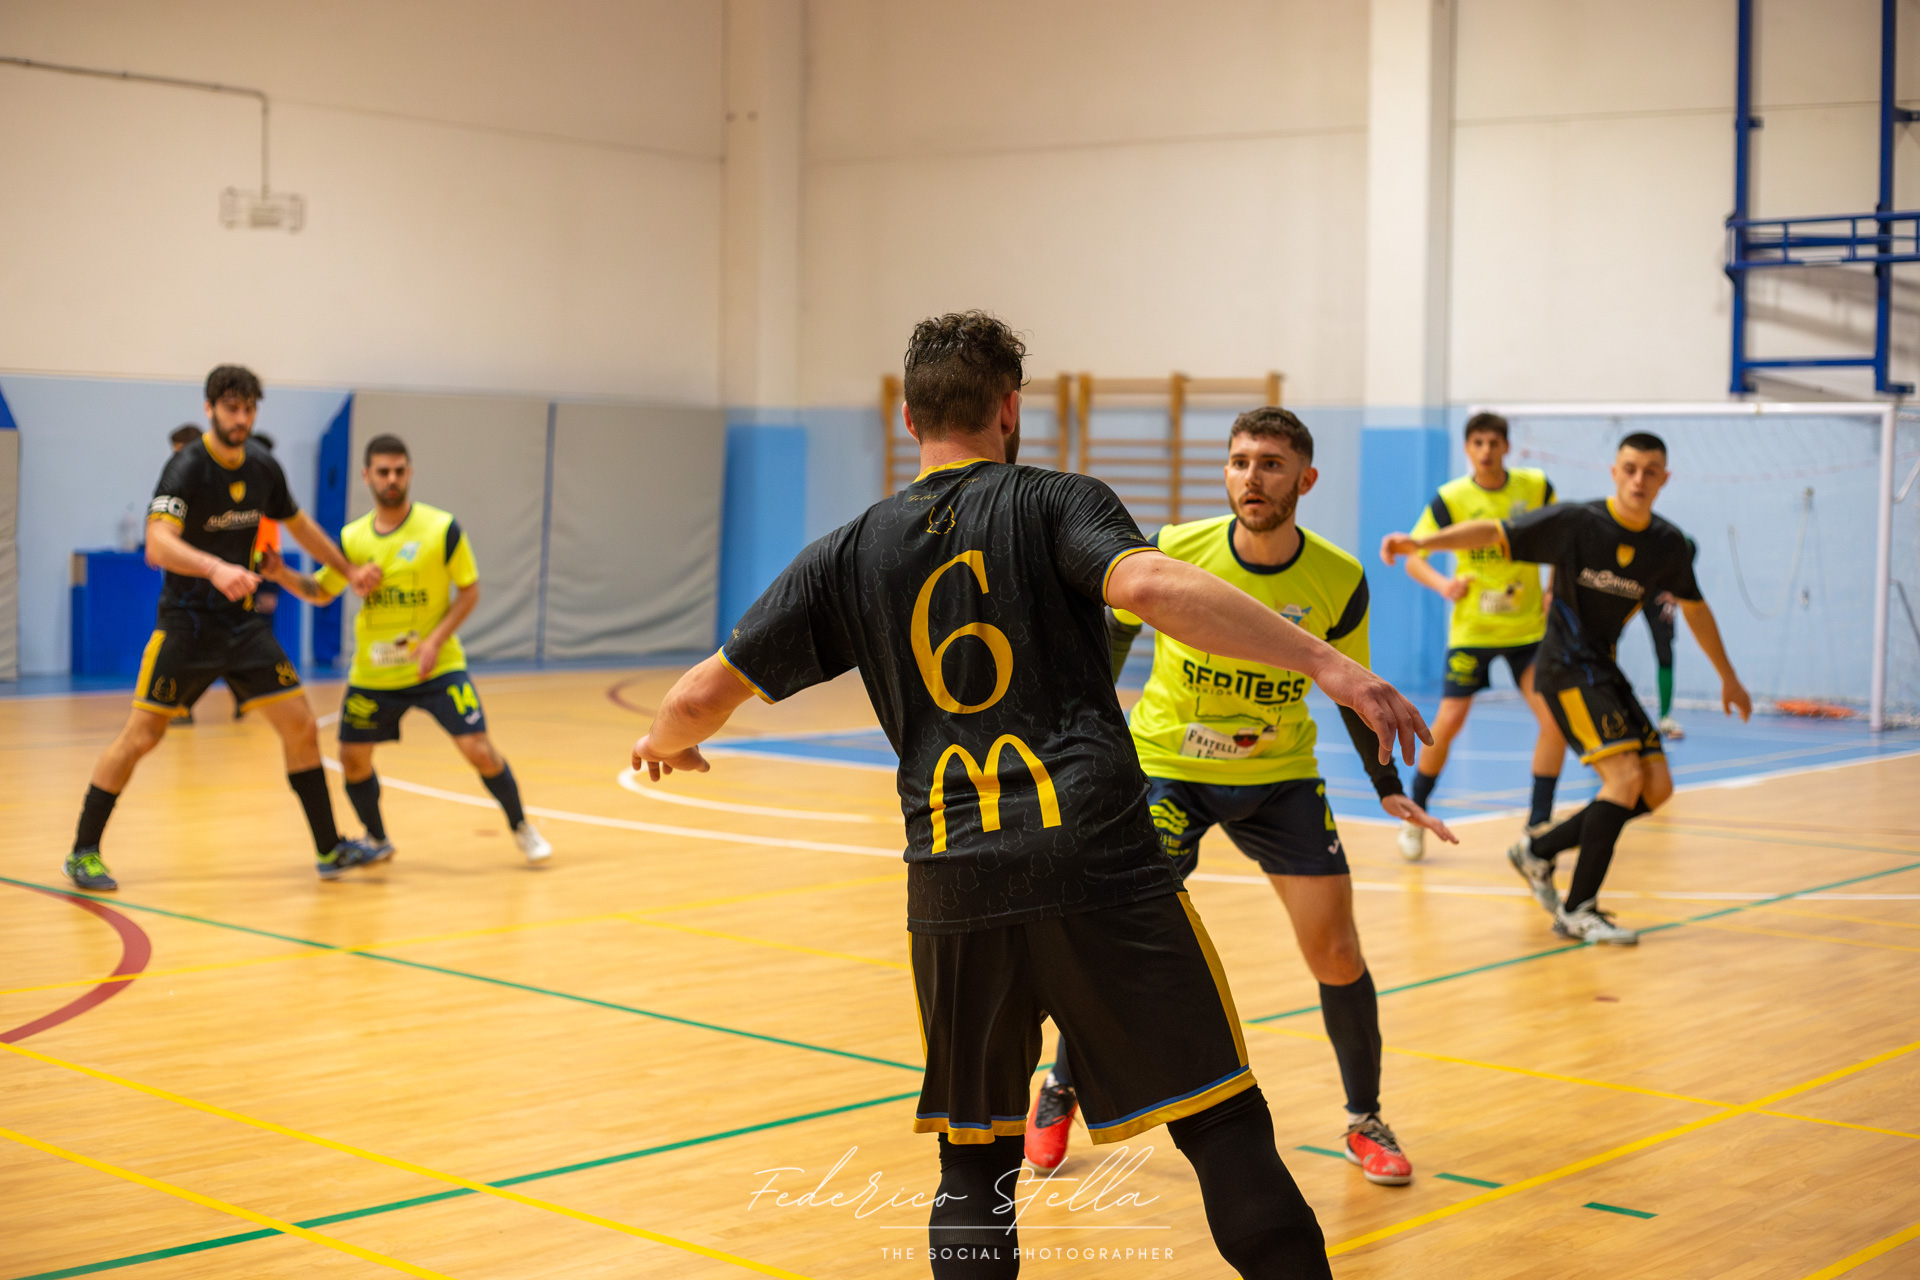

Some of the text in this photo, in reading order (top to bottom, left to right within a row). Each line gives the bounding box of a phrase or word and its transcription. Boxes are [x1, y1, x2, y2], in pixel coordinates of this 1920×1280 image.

[911, 550, 1013, 714] 6
[446, 682, 479, 715] 14
[1188, 729, 1238, 754] FRATELLI
